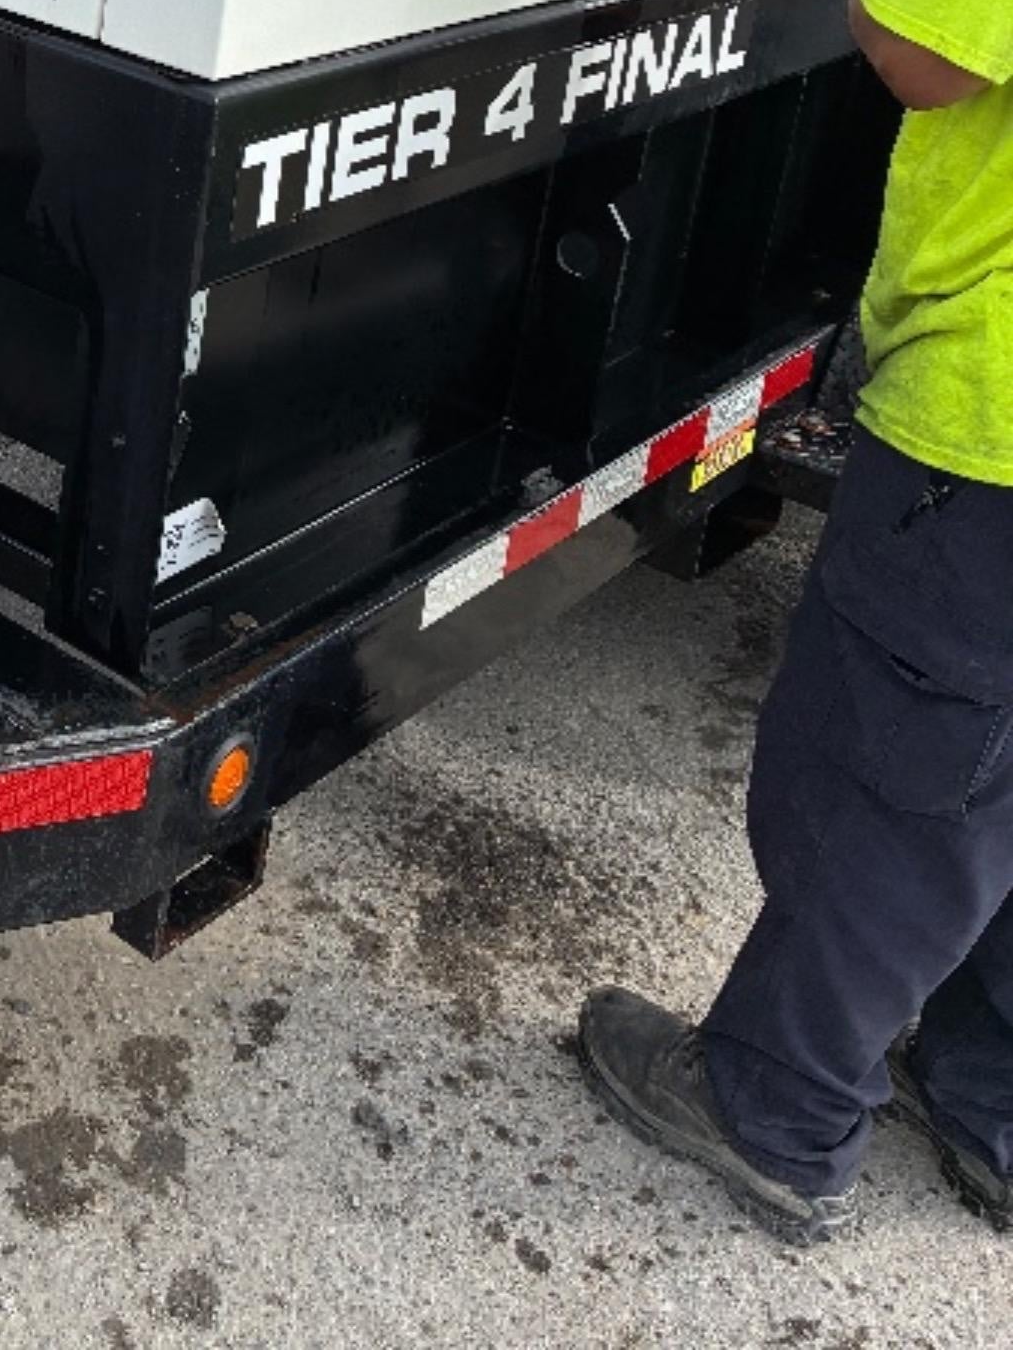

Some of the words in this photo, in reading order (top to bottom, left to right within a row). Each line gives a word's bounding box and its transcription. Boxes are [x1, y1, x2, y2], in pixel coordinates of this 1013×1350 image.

[241, 85, 456, 229] TIER
[483, 61, 537, 143] 4
[559, 5, 748, 127] FINAL
